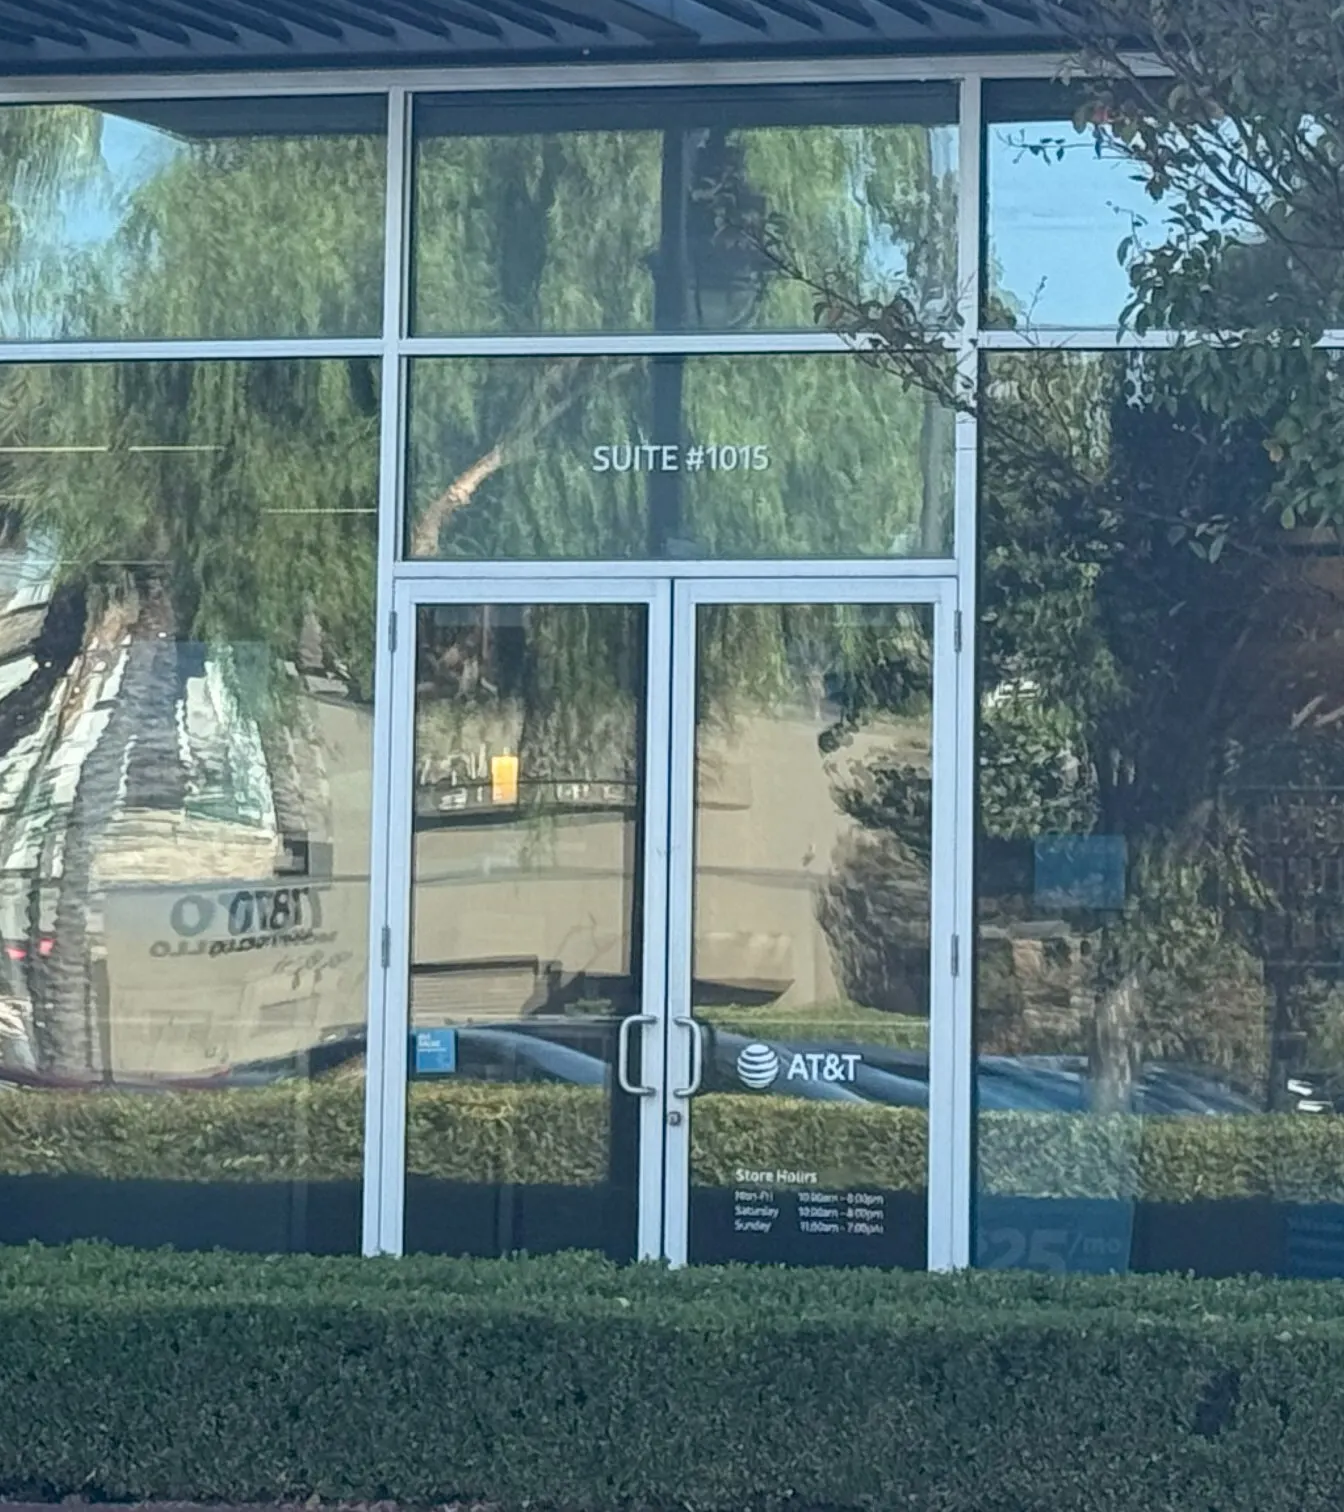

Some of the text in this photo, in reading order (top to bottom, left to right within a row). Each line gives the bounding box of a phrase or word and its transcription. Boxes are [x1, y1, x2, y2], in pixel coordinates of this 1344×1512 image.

[592, 445, 770, 471] SUITE #1015
[787, 1053, 861, 1081] AT&T
[736, 1168, 817, 1184] Store Hours
[735, 1219, 772, 1234] Sunday
